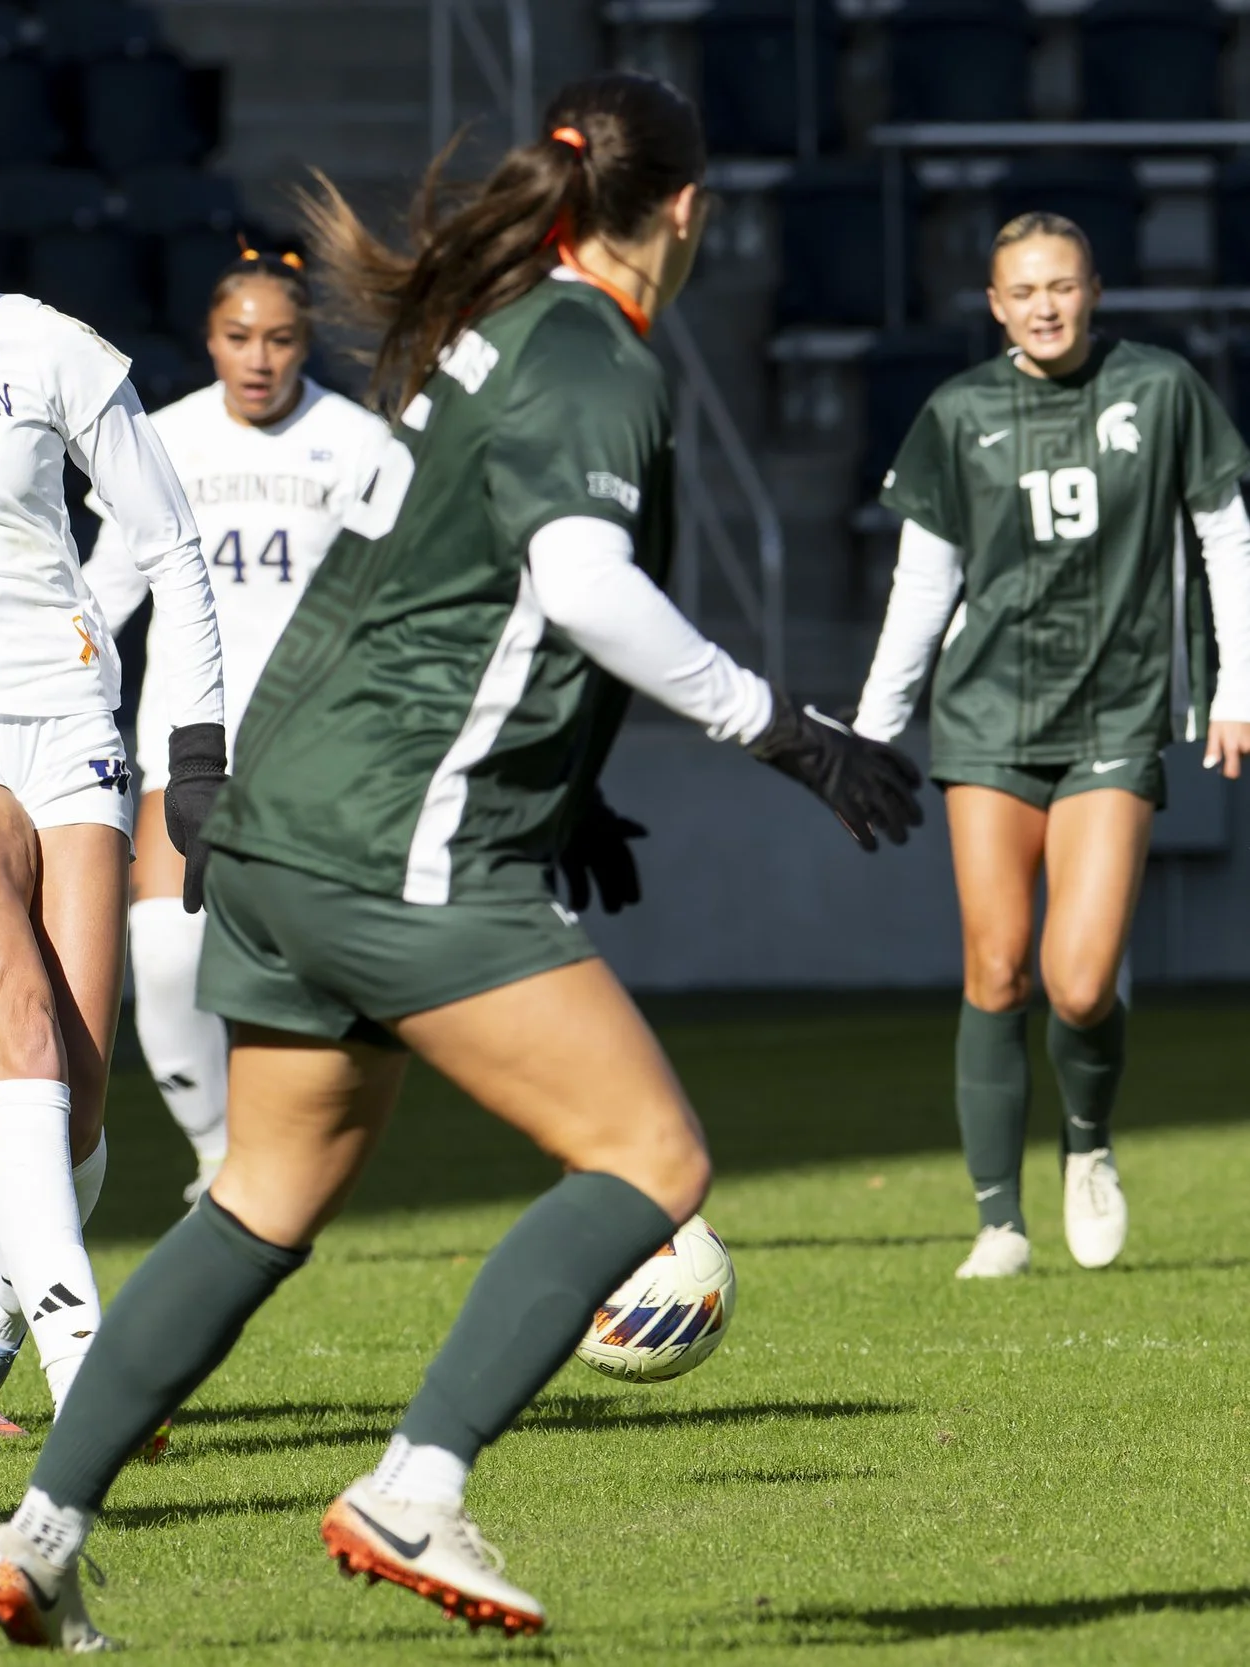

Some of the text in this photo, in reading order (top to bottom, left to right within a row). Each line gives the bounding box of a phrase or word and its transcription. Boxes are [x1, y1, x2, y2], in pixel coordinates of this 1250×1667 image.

[187, 473, 340, 513] ASHINGTON
[1019, 467, 1099, 541] 19
[213, 529, 293, 583] 44
